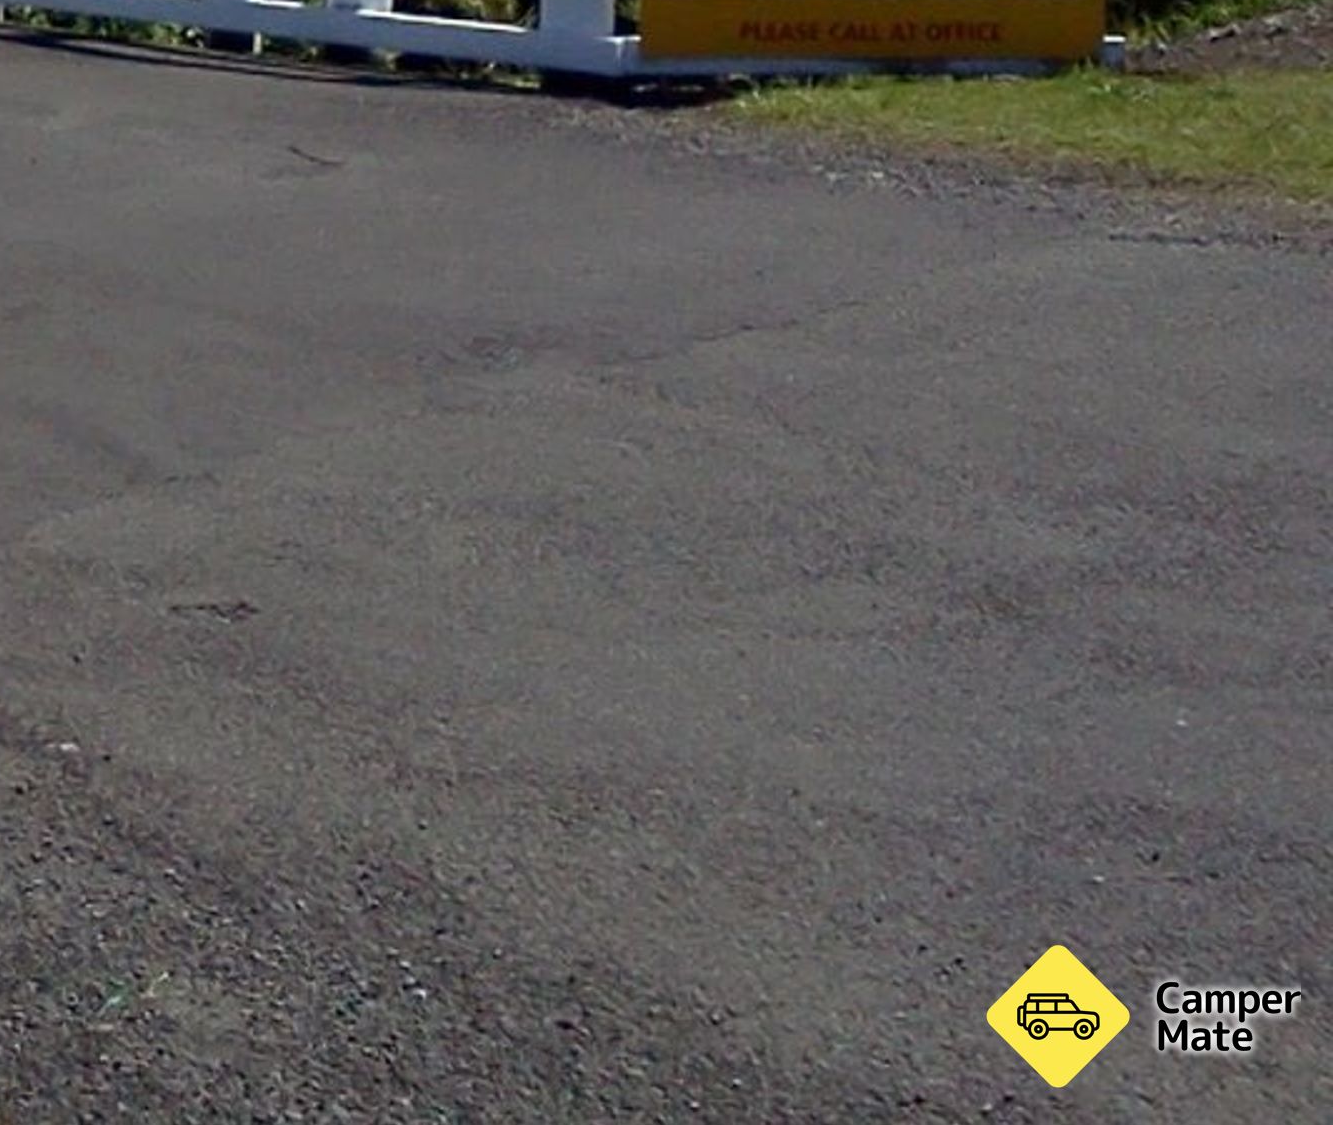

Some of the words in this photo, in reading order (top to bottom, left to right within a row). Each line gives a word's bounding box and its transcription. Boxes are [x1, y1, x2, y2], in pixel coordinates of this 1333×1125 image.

[740, 21, 821, 43] PLEASE
[828, 21, 882, 42] CALL
[889, 21, 920, 42] AT
[927, 21, 1003, 42] OFFICE
